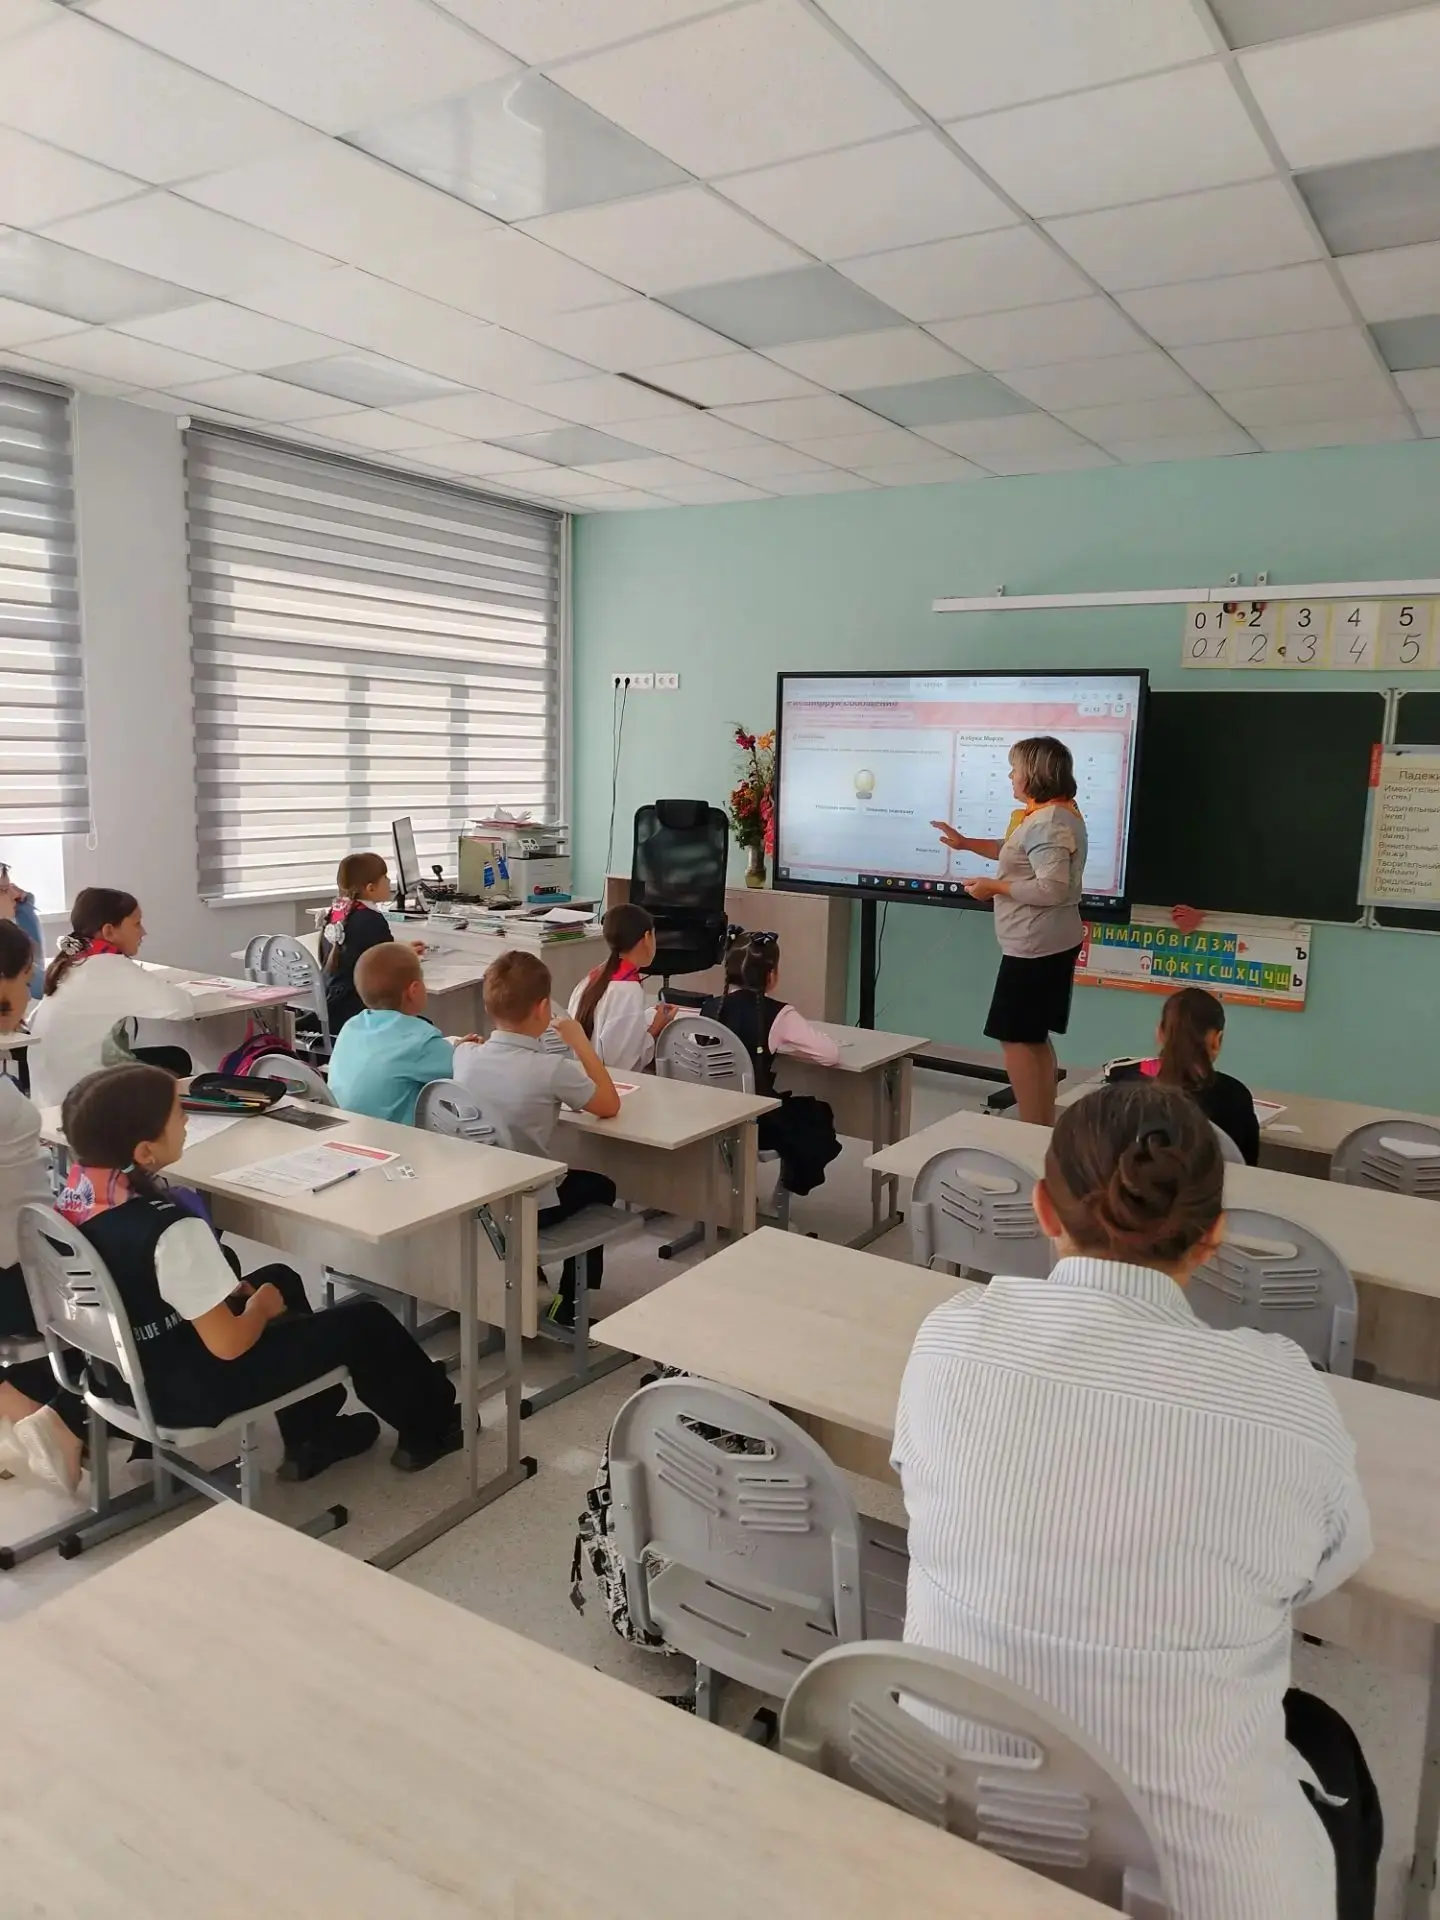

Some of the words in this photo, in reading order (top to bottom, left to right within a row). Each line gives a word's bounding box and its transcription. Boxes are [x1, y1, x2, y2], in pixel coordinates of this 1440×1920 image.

[1195, 612, 1206, 629] 0
[1215, 611, 1223, 628] 1
[1248, 610, 1263, 627] 2
[1298, 608, 1311, 628] 3
[1347, 608, 1361, 626] 4
[1399, 606, 1414, 626] 5
[1192, 637, 1207, 658] 0
[1215, 637, 1227, 658] 1
[1248, 633, 1268, 663] 2
[1297, 634, 1317, 663] 3
[1349, 635, 1367, 664] 4
[1399, 633, 1421, 664] 5
